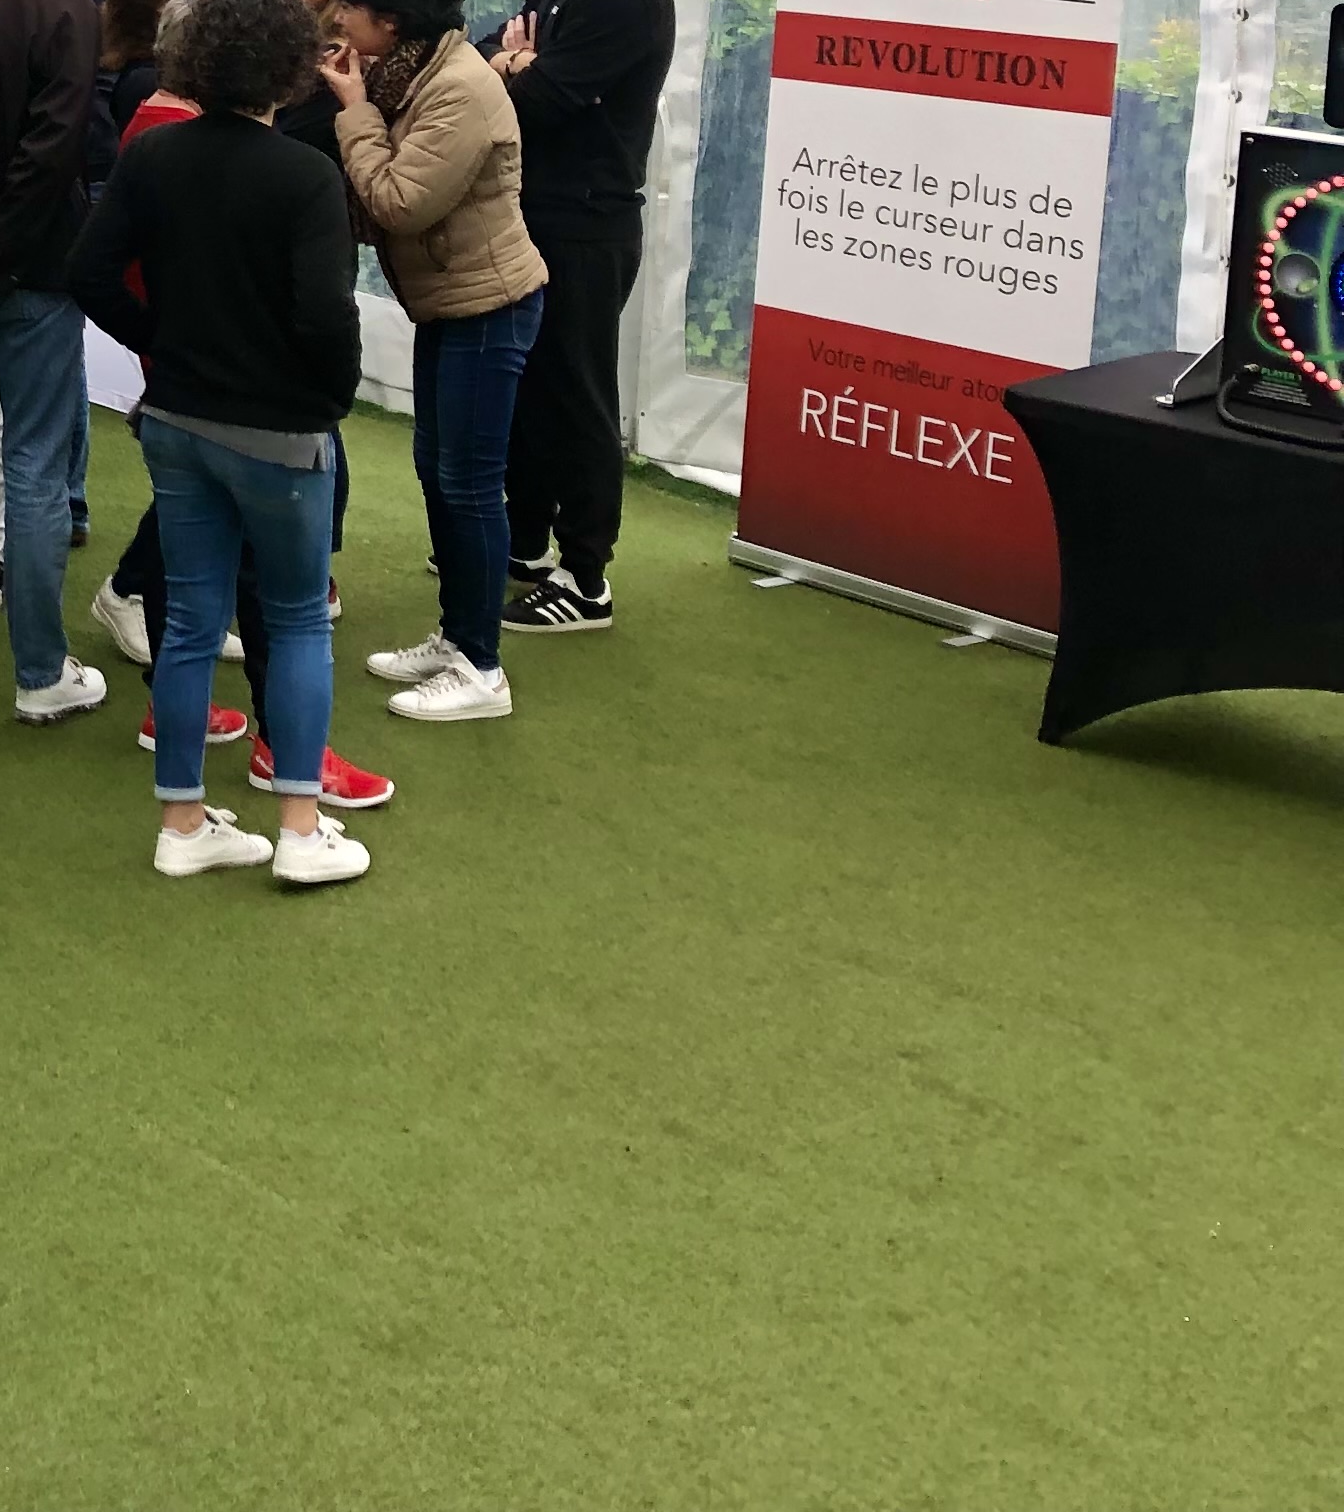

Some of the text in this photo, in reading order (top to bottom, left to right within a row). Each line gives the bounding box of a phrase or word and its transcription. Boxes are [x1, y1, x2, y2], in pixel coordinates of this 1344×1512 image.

[815, 34, 1068, 90] REVOLUTION
[778, 179, 1085, 260] fois le curseur dans
[792, 147, 1073, 218] Arrêtez le plus de
[794, 218, 1059, 295] les zones rouges
[808, 338, 1005, 403] Votre meilleur ato
[800, 385, 1015, 484] RÉFLEXE
